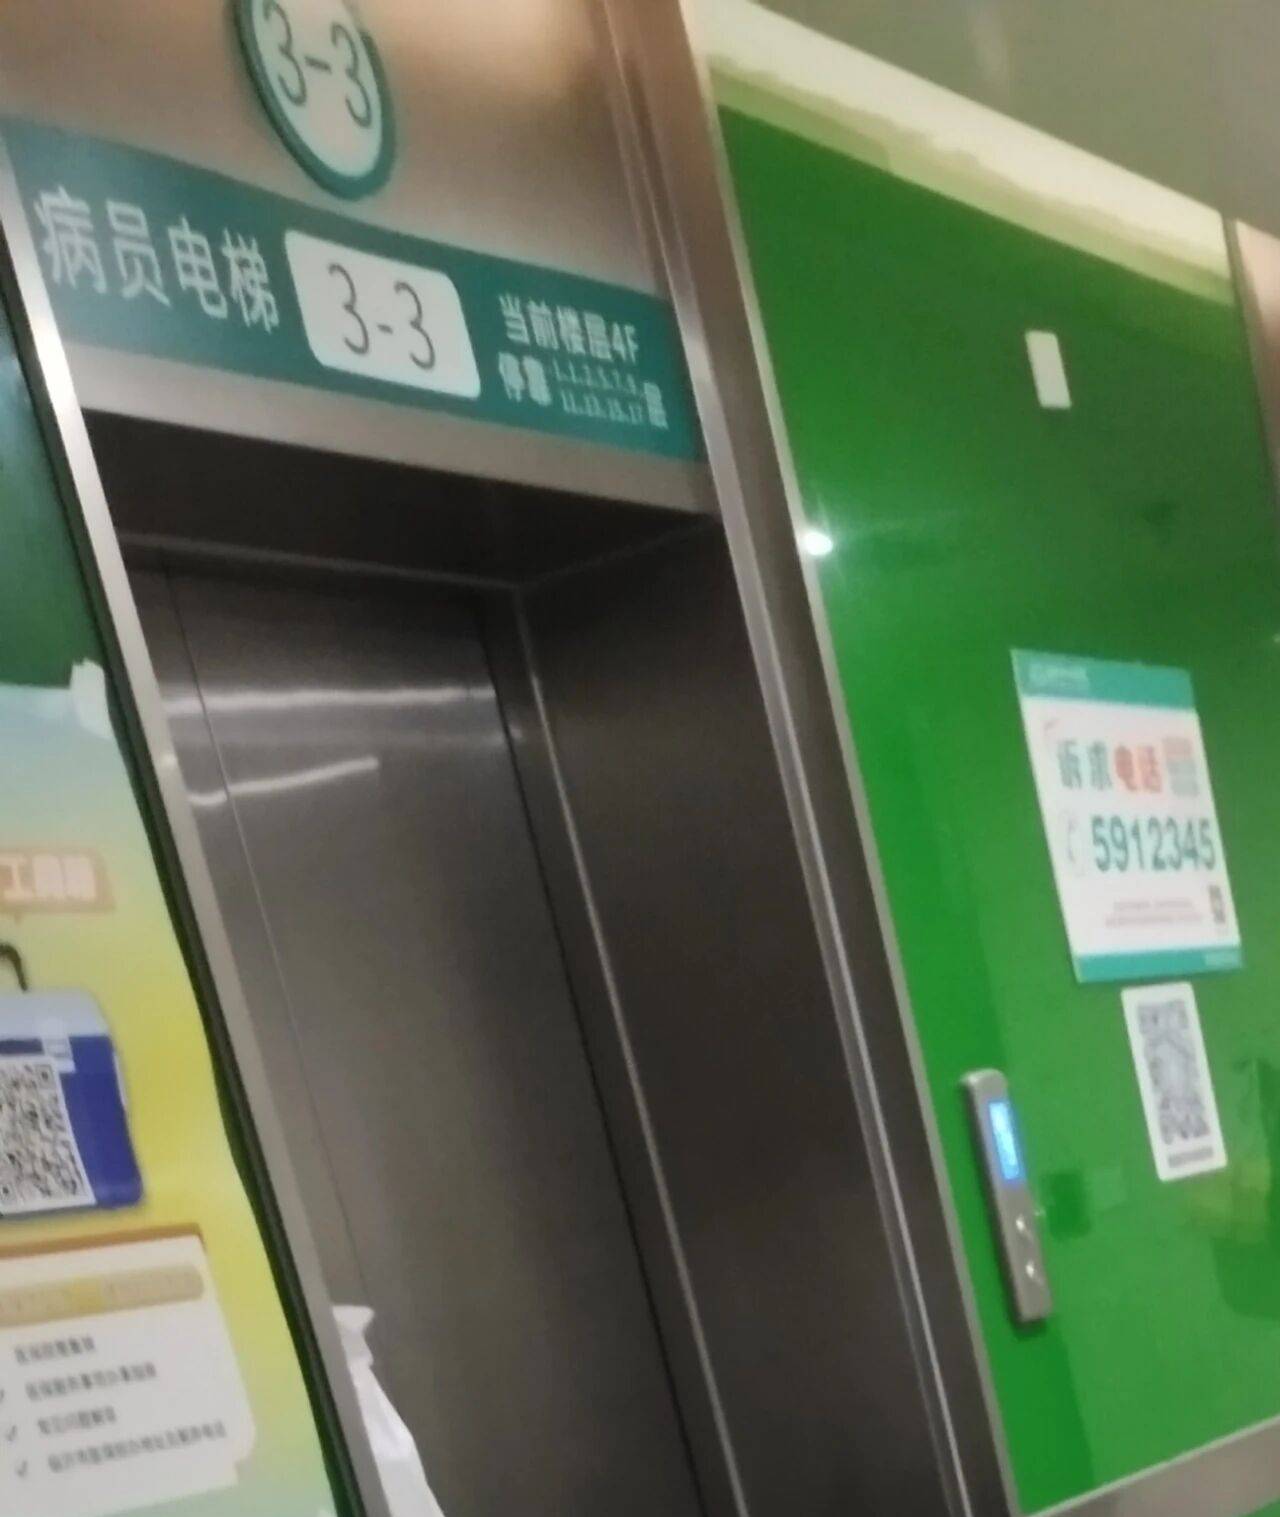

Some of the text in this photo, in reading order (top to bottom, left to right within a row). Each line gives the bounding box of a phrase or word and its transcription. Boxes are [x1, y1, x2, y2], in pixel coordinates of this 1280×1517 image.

[262, 0, 374, 129] 3-3
[34, 184, 279, 336] 病员电梯
[327, 262, 437, 371] 3-3
[1091, 815, 1216, 873] 5912345
